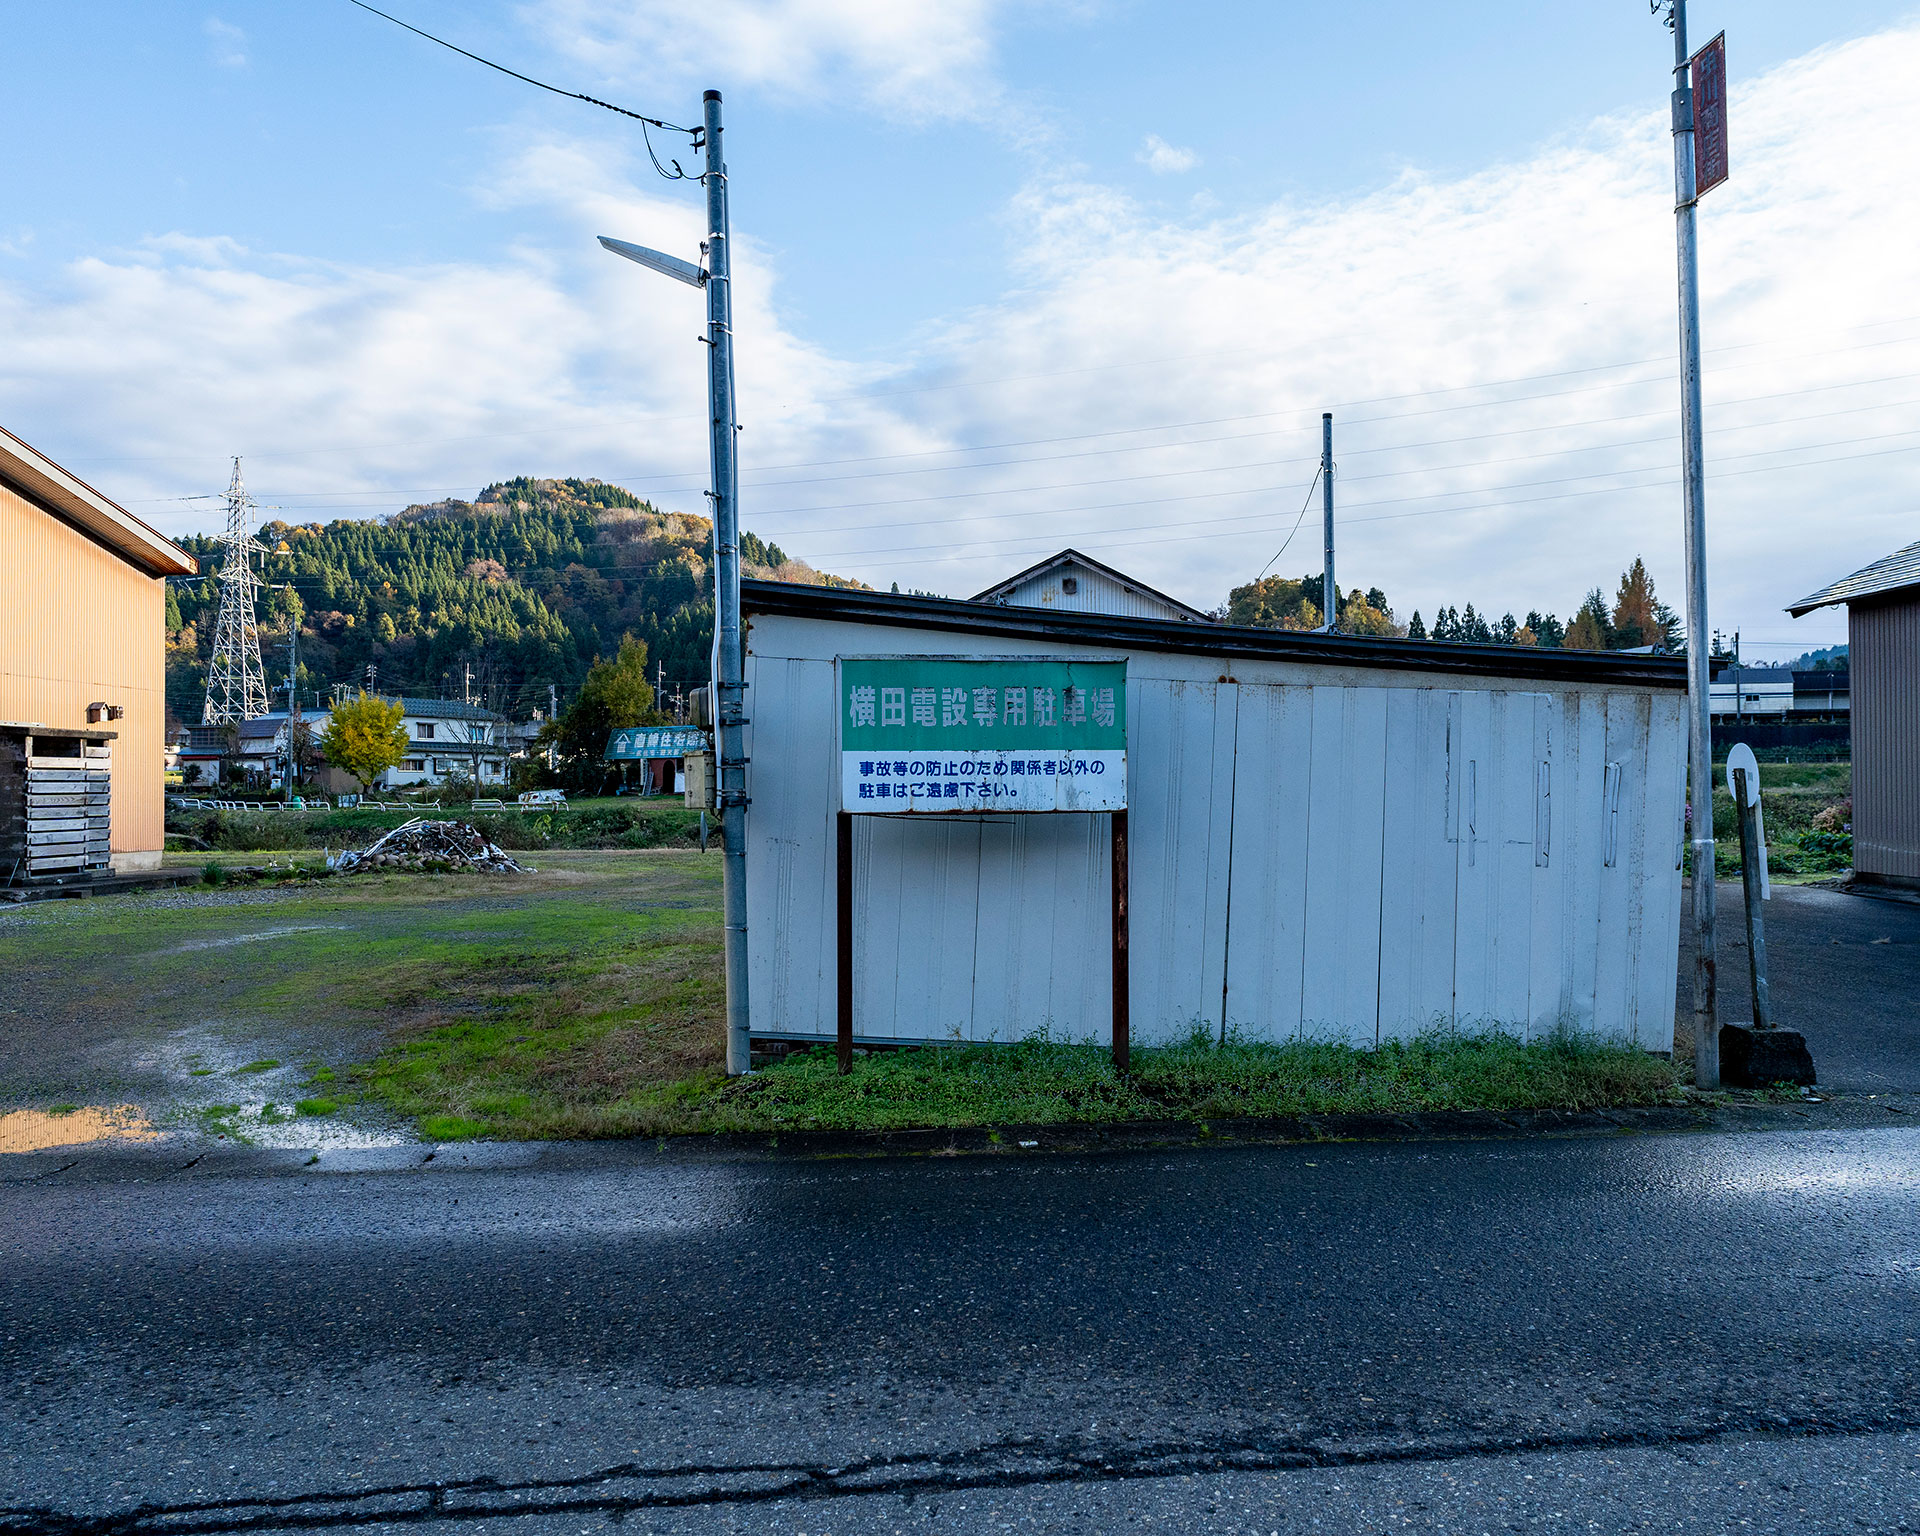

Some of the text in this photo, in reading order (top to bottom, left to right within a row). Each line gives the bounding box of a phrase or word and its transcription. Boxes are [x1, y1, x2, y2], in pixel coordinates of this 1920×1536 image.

[849, 686, 1116, 728] 横田電設専用駐車場
[859, 760, 1105, 777] 事故等の防止のため関係者以外の
[858, 782, 1018, 799] 駐車はご遠慮下さい。
